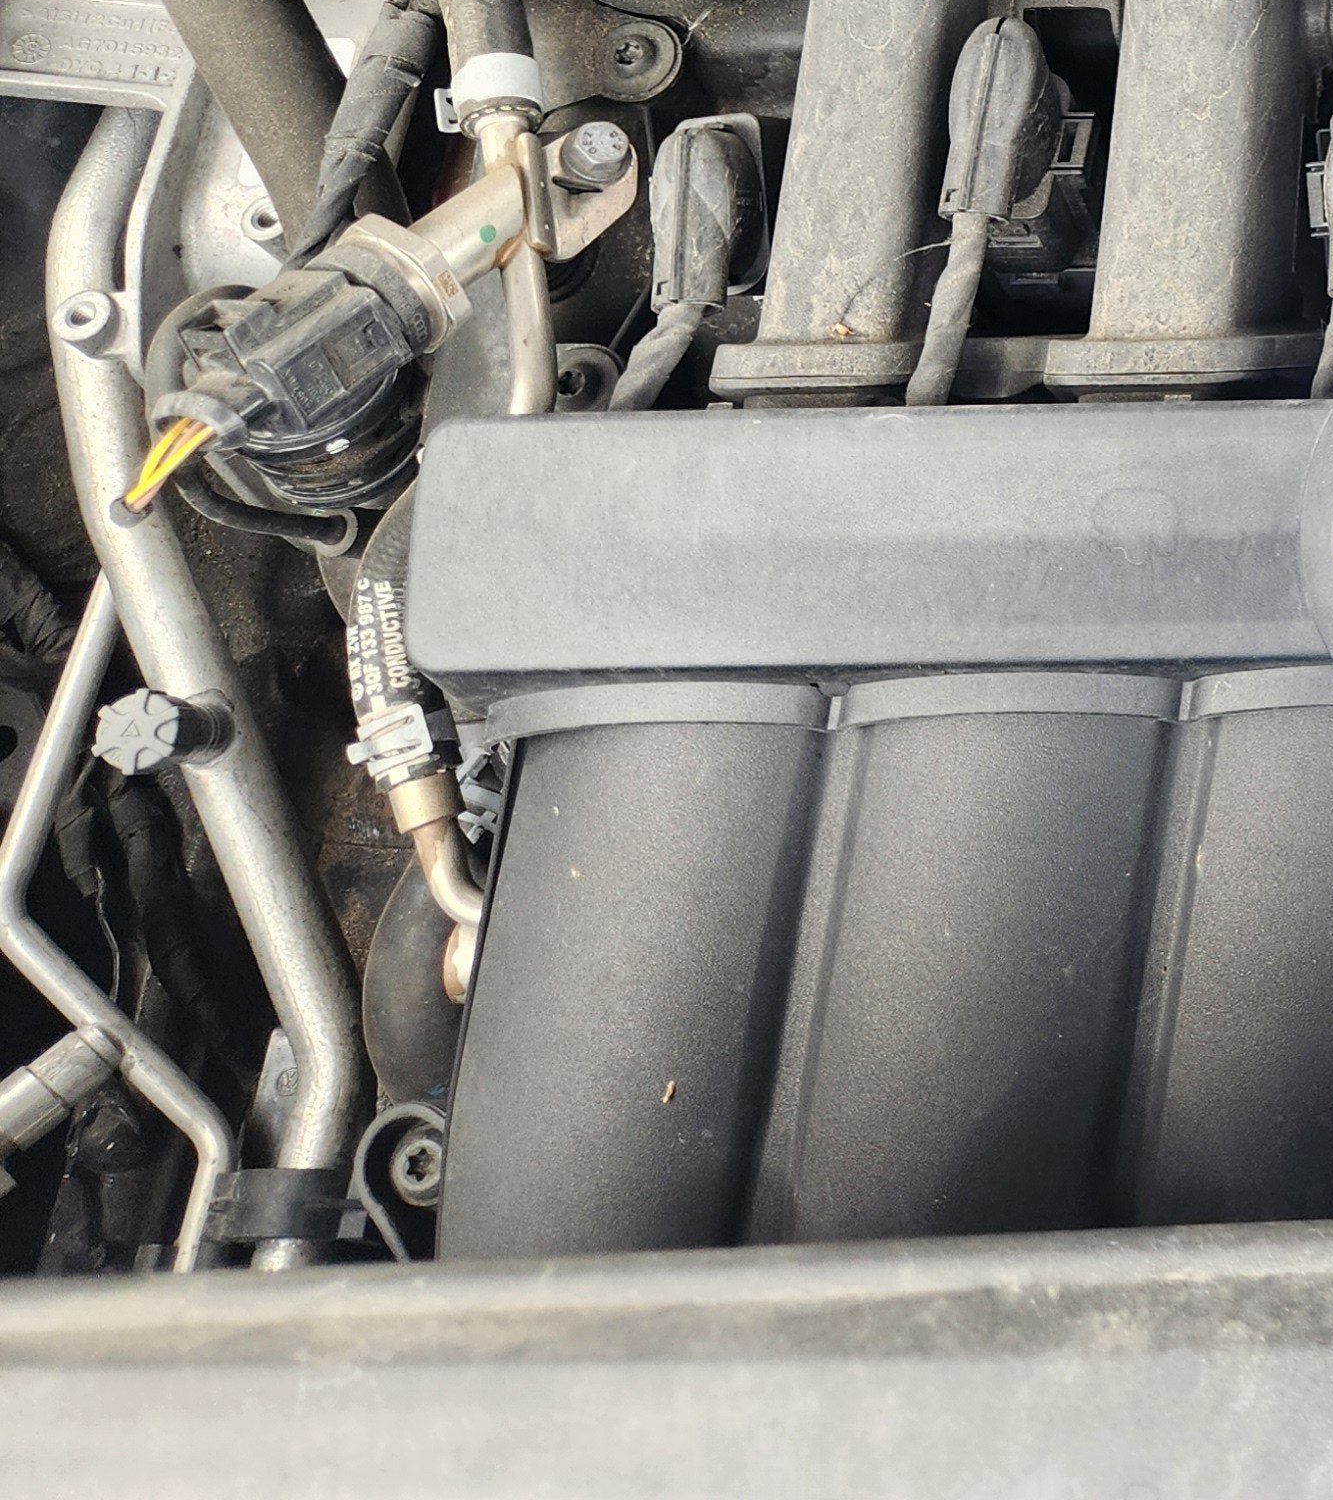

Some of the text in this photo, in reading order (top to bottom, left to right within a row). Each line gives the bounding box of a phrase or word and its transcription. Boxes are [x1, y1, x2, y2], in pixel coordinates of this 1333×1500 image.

[357, 577, 370, 590] C
[358, 595, 374, 626] 987
[359, 628, 378, 659] 133
[374, 581, 411, 688] CONDUCTIVE
